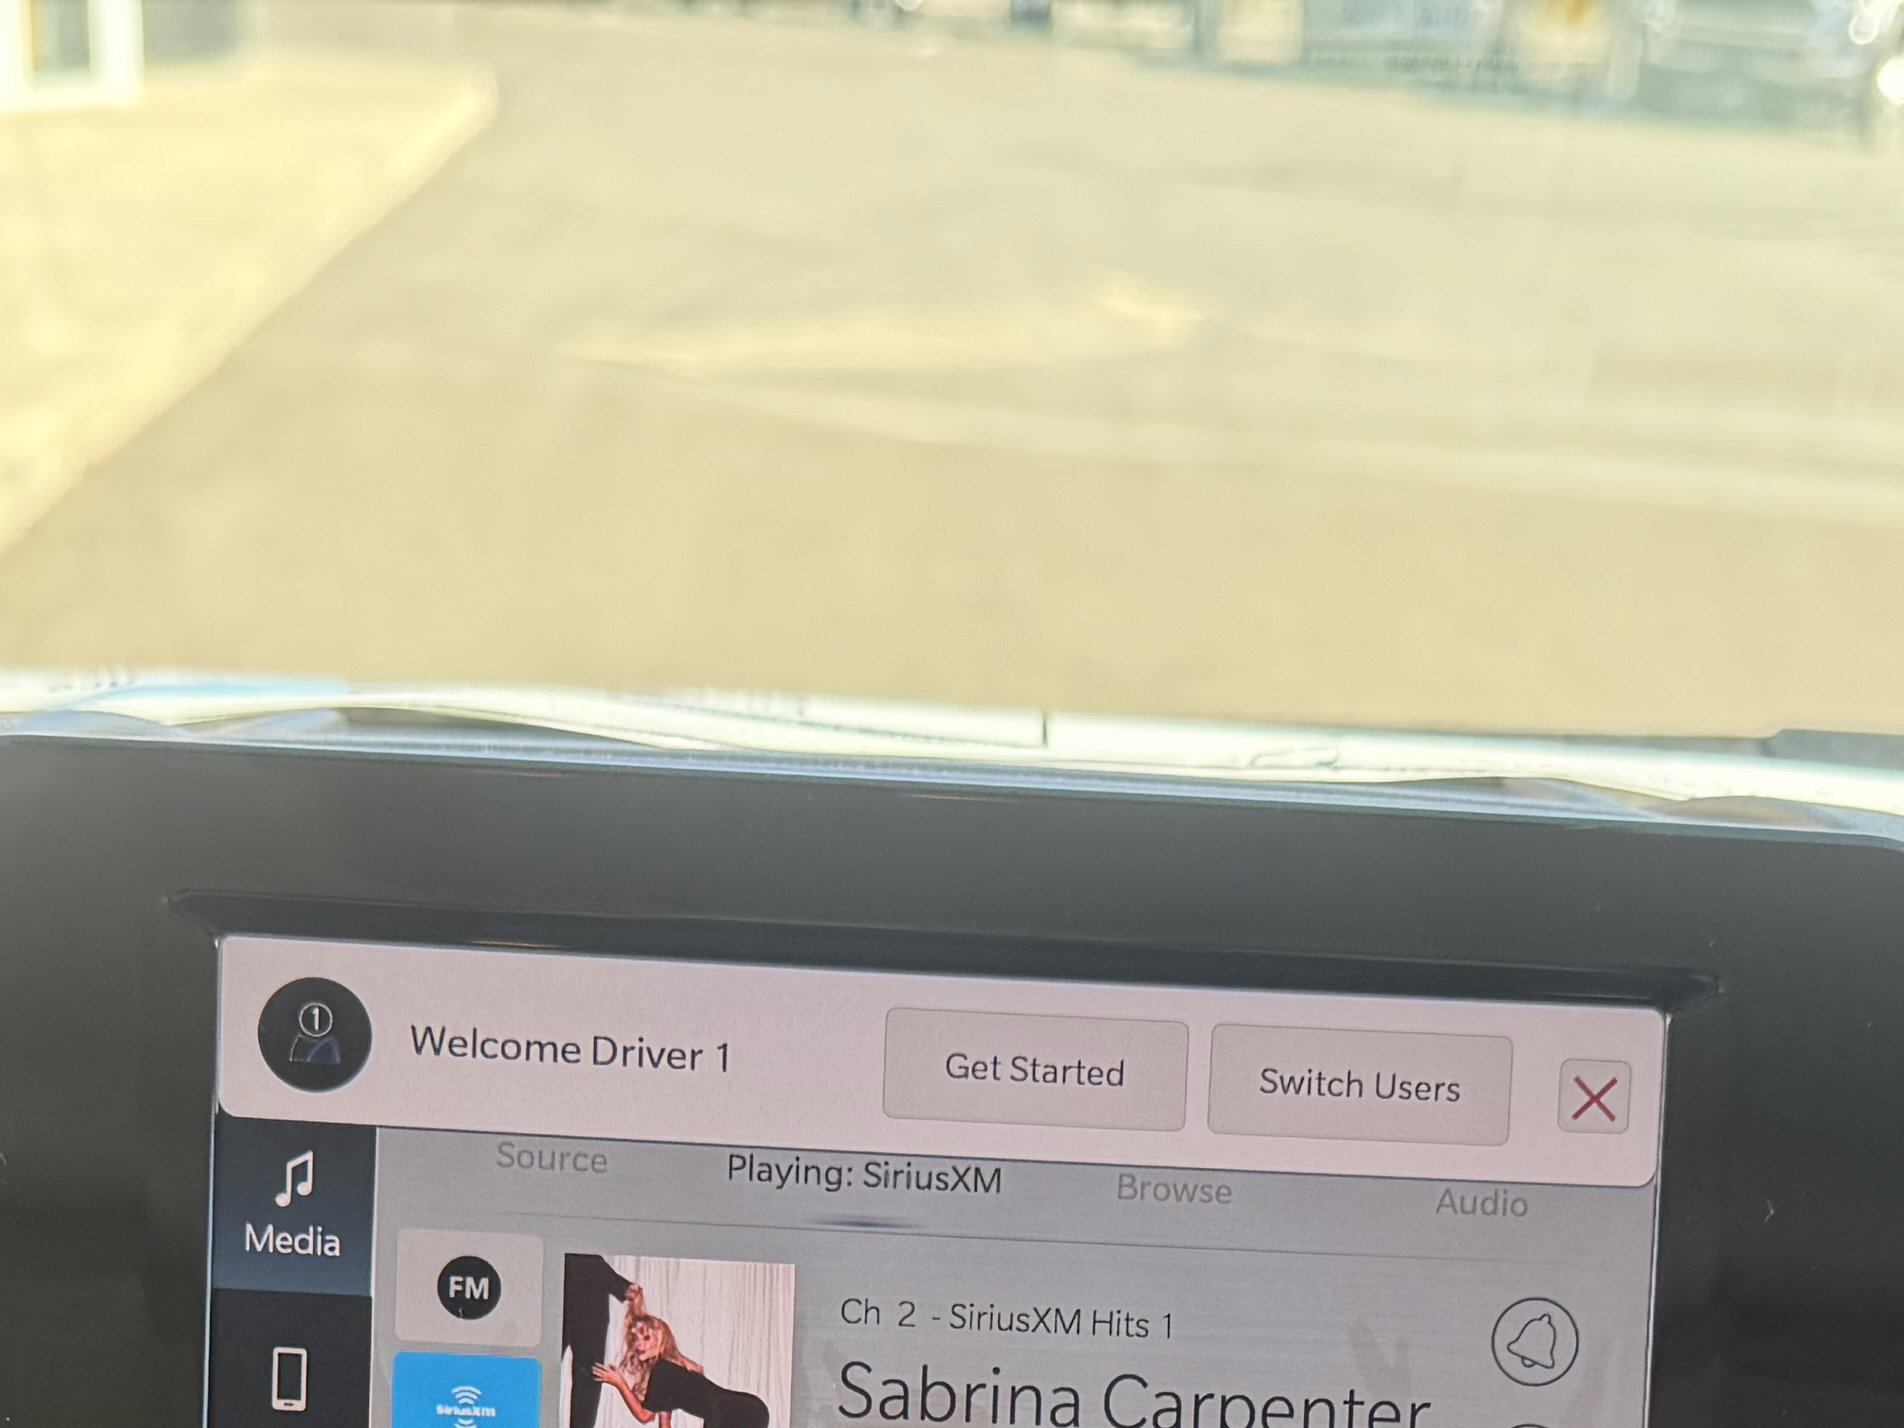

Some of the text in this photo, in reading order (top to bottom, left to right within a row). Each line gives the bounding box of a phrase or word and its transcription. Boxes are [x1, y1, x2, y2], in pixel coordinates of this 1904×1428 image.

[410, 1024, 731, 1073] Welcome Driver 1
[945, 1053, 1125, 1088] Get Started
[1260, 1069, 1461, 1103] Switch Users
[497, 1142, 607, 1174] Source
[728, 1155, 1003, 1194] Playing: SiriusXM
[1117, 1175, 1233, 1204] Browse
[1436, 1188, 1528, 1218] Audio
[245, 1224, 340, 1258] Media
[449, 1276, 489, 1300] FM
[841, 1299, 880, 1327] Ch
[898, 1302, 917, 1329] 2
[949, 1305, 1082, 1336] SiriusXM
[1092, 1310, 1150, 1339] Hits
[1163, 1314, 1173, 1340] 1
[838, 1360, 1080, 1428] Sabrina
